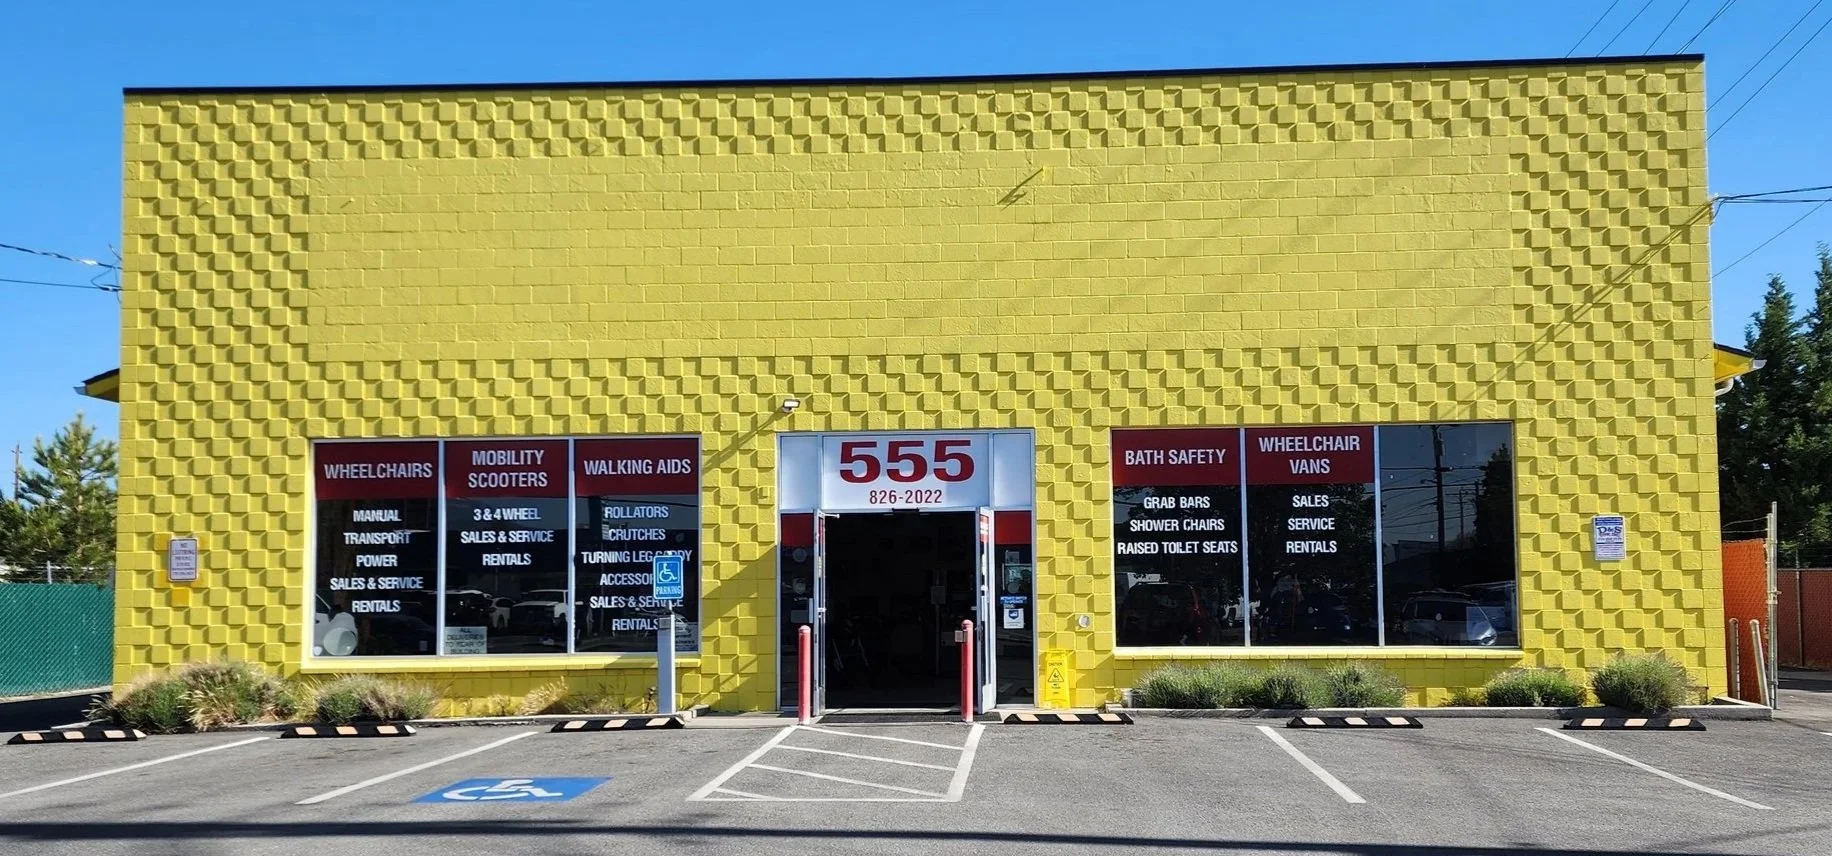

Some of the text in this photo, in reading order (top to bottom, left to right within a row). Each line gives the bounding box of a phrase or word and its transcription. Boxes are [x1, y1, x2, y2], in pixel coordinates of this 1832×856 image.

[1259, 436, 1360, 453] WHEELCHAIR
[472, 450, 544, 466] MOBILITY
[840, 440, 975, 483] 555
[1126, 448, 1226, 466] BATH SAFETY
[325, 463, 432, 479] WHEELCHAIRS
[584, 459, 691, 475] WALKING AIDS
[1290, 458, 1330, 474] VANS
[468, 472, 548, 488] SCOOTERS
[869, 489, 942, 504] 826-2022
[1144, 496, 1210, 509] GRAB BARS
[1292, 495, 1329, 508] SALES
[353, 509, 402, 523] MANUAL
[474, 508, 541, 521] 3 & 4 WHEEL
[605, 506, 669, 520] ROLLATORS
[1130, 518, 1225, 531] SHOWER CHAIRS
[1288, 518, 1334, 530] SERVICE
[344, 532, 411, 545] TRANSPORT
[461, 530, 554, 544] SALES & SERVICE
[609, 528, 665, 541] CRUTCHES
[1118, 541, 1238, 554] RAISED TOILET SEATS
[1286, 540, 1337, 553] RENTALS
[356, 555, 397, 567] POWER
[483, 553, 531, 566] RENTALS
[582, 549, 692, 564] TURNING LEG CDY
[330, 577, 423, 591] SALES & SERVICE
[600, 573, 653, 586] ACCESSO
[656, 585, 681, 595] PARKING
[352, 600, 400, 613] RENTALS
[590, 595, 683, 609] SALES & SERVE
[613, 618, 658, 631] RENTALS
